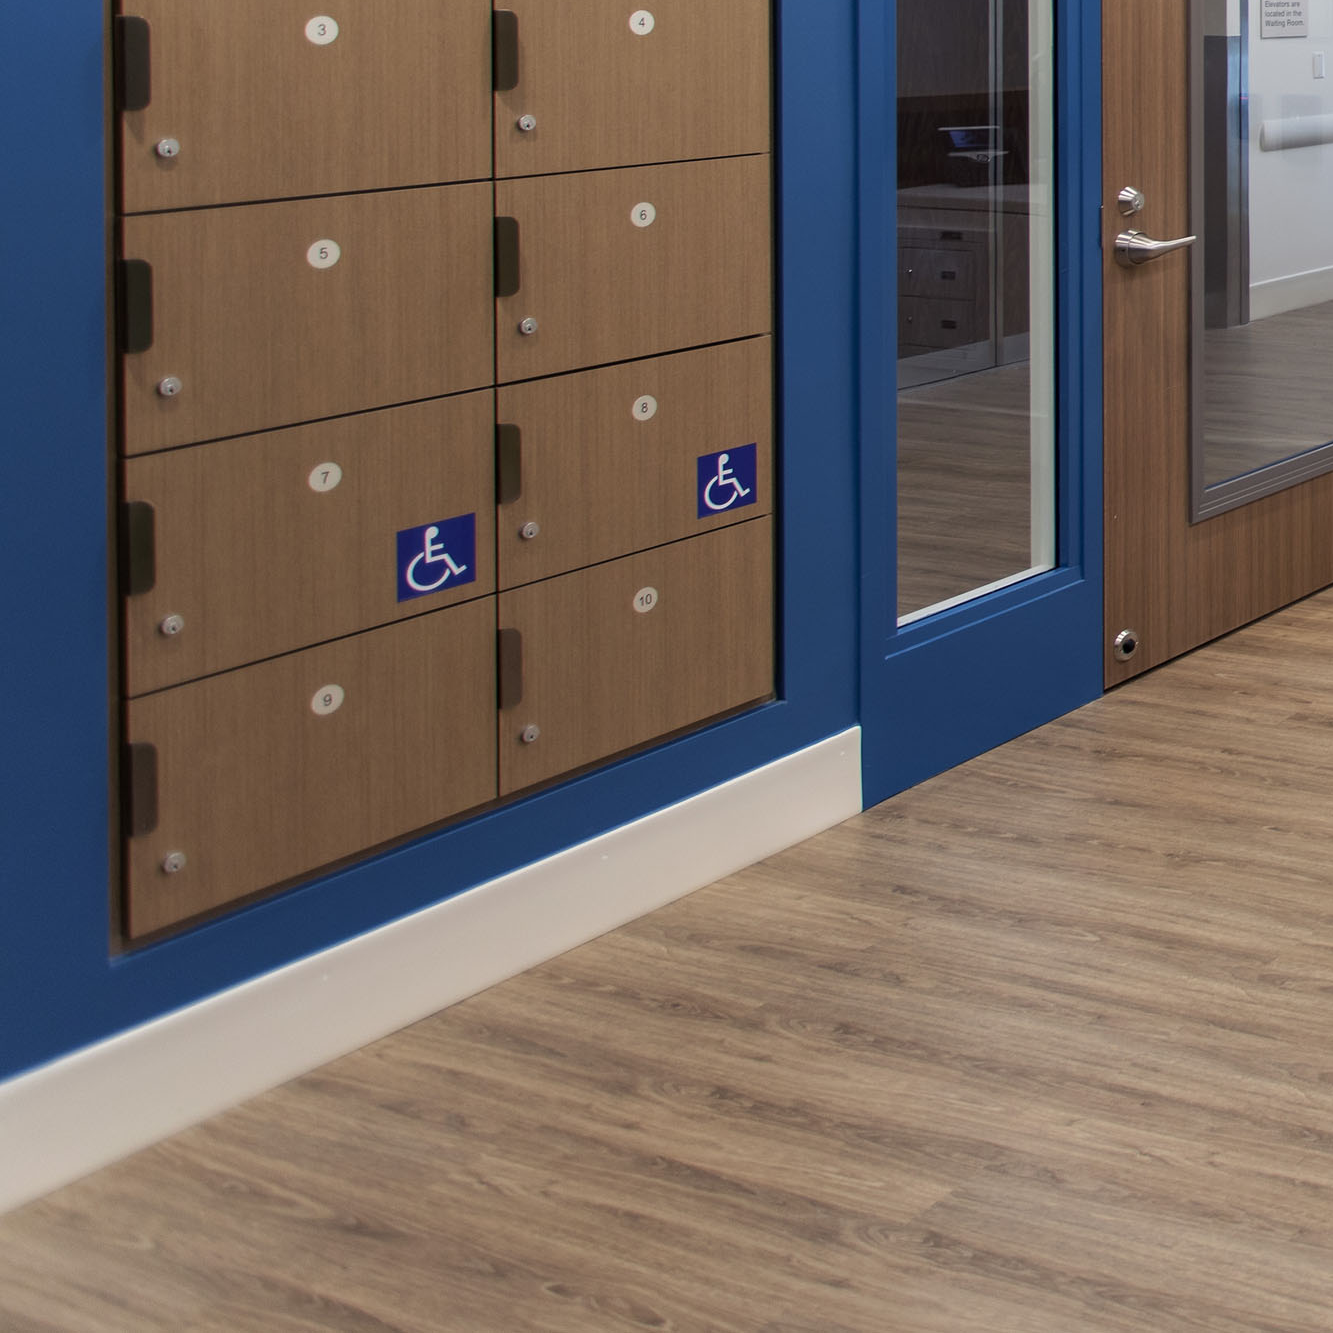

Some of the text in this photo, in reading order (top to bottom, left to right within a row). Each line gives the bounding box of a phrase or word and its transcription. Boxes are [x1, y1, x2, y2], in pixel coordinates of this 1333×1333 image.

[638, 17, 645, 27] 4
[317, 24, 327, 36] 3
[639, 209, 647, 221] 6
[319, 247, 329, 259] 5
[640, 402, 648, 413] 8
[321, 471, 330, 484] 7
[639, 593, 652, 606] 10
[322, 693, 332, 707] 9
